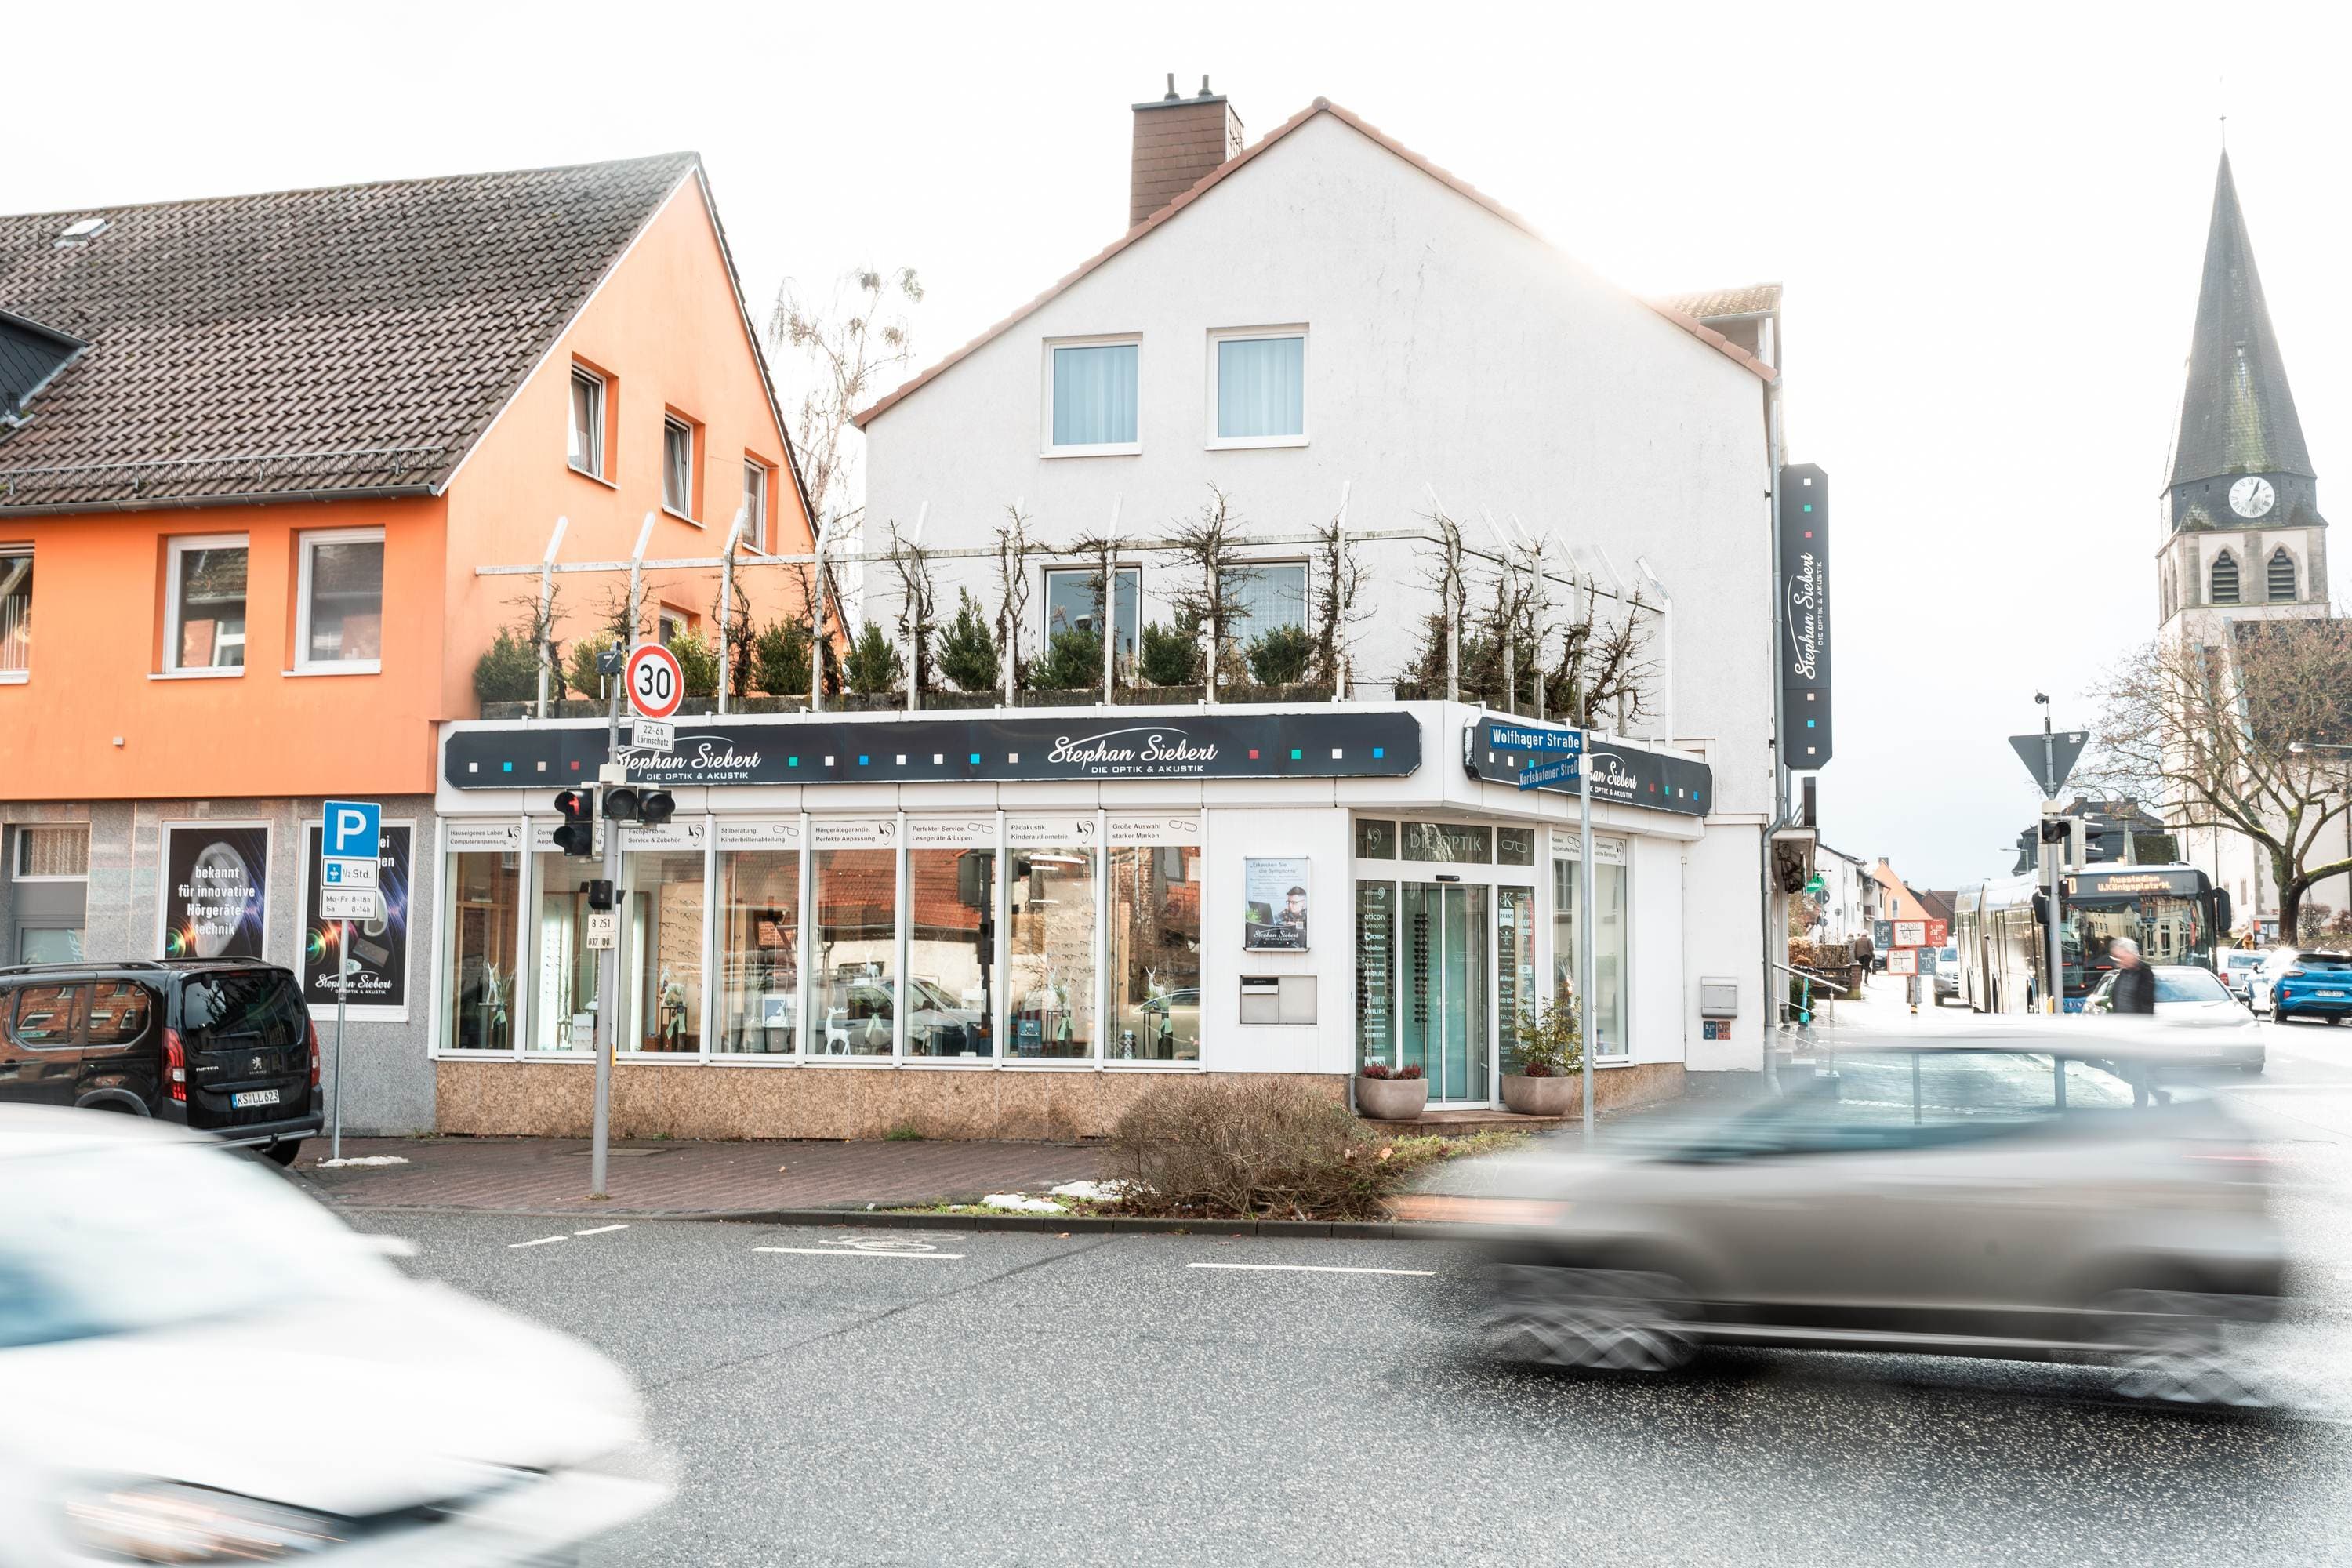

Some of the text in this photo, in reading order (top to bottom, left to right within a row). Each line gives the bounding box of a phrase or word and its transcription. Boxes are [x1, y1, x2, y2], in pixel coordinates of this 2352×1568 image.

[1794, 552, 1820, 680] Stephan Siebert
[639, 664, 670, 699] 30
[644, 725, 664, 735] 22-6h
[637, 735, 669, 746] Lärmschutz
[1493, 729, 1580, 749] Wolfhager Straße
[691, 743, 761, 769] Siebert
[1047, 735, 1218, 770] Stephan Siebert
[1520, 768, 1559, 786] Karlshafener
[1607, 760, 1637, 789] Siebert
[336, 809, 367, 851] P
[1410, 833, 1482, 851] DIE OPTIK
[195, 866, 239, 878] bekannt
[352, 869, 371, 879] Std.
[2109, 875, 2160, 884] Auestadion
[178, 884, 255, 897] für innovative
[187, 903, 245, 919] Hörgeräte-
[194, 922, 235, 935] technik
[592, 918, 610, 928] B 251
[358, 974, 392, 989] Siebert
[237, 1091, 278, 1104] KS LL 623
